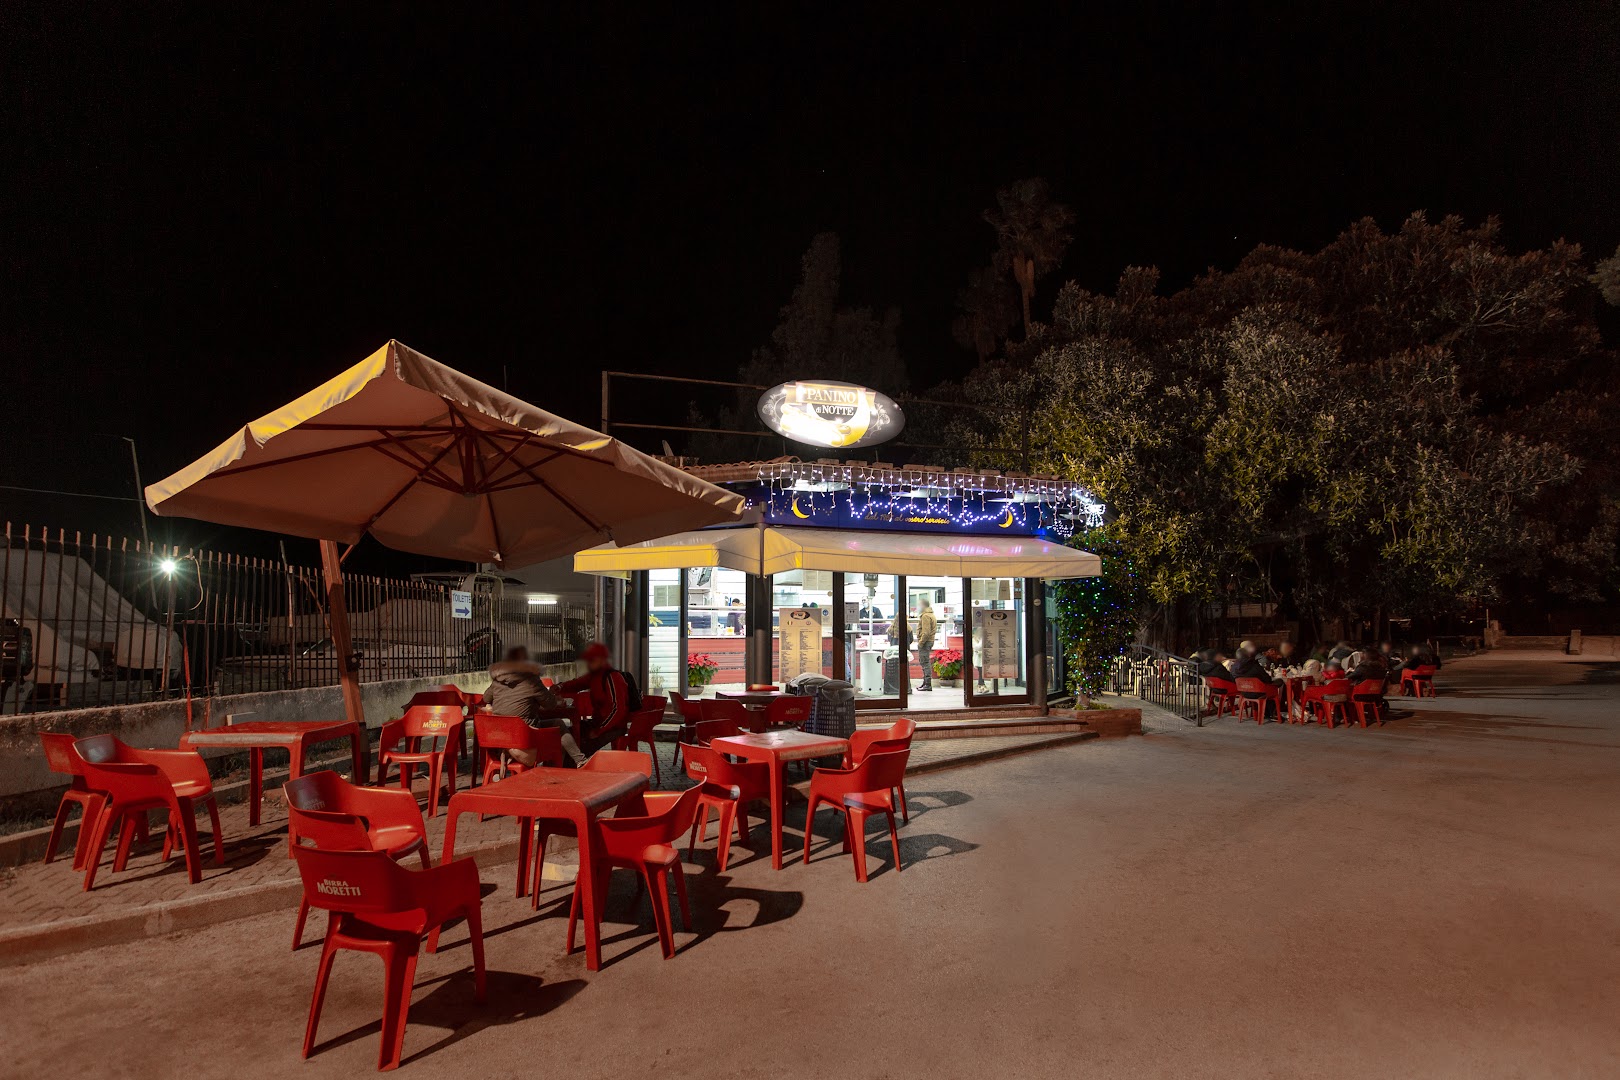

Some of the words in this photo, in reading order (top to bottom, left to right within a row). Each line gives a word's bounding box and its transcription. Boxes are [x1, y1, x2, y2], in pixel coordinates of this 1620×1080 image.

[806, 388, 857, 404] PANINO
[822, 404, 855, 416] NOTTE
[316, 881, 362, 897] MORETTI
[323, 878, 349, 887] BIRRA
